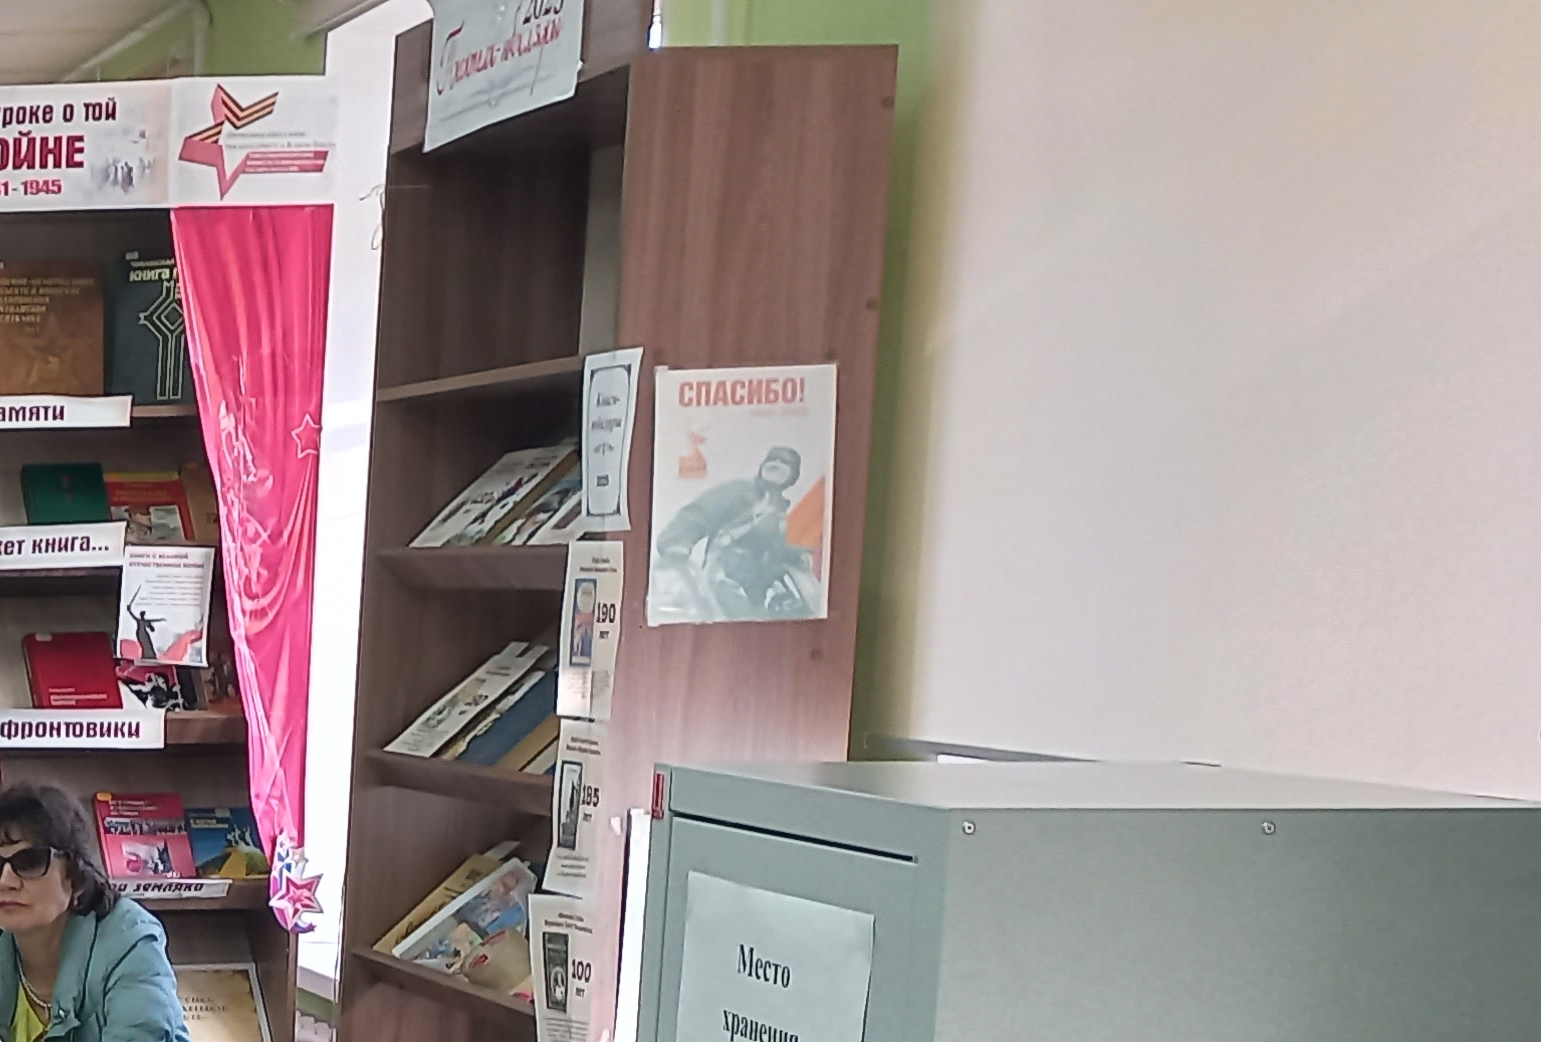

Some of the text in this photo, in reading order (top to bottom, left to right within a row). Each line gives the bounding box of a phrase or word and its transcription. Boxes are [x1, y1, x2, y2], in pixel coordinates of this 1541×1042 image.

[63, 104, 76, 123] о
[82, 96, 117, 122] той
[129, 268, 171, 283] КНИГА
[678, 377, 806, 408] СПАСИБО!
[31, 535, 111, 555] книга...
[596, 602, 617, 624] 190
[0, 718, 142, 741] фронтовики
[581, 786, 600, 808] 185
[571, 959, 592, 984] 100
[736, 943, 792, 990] Место
